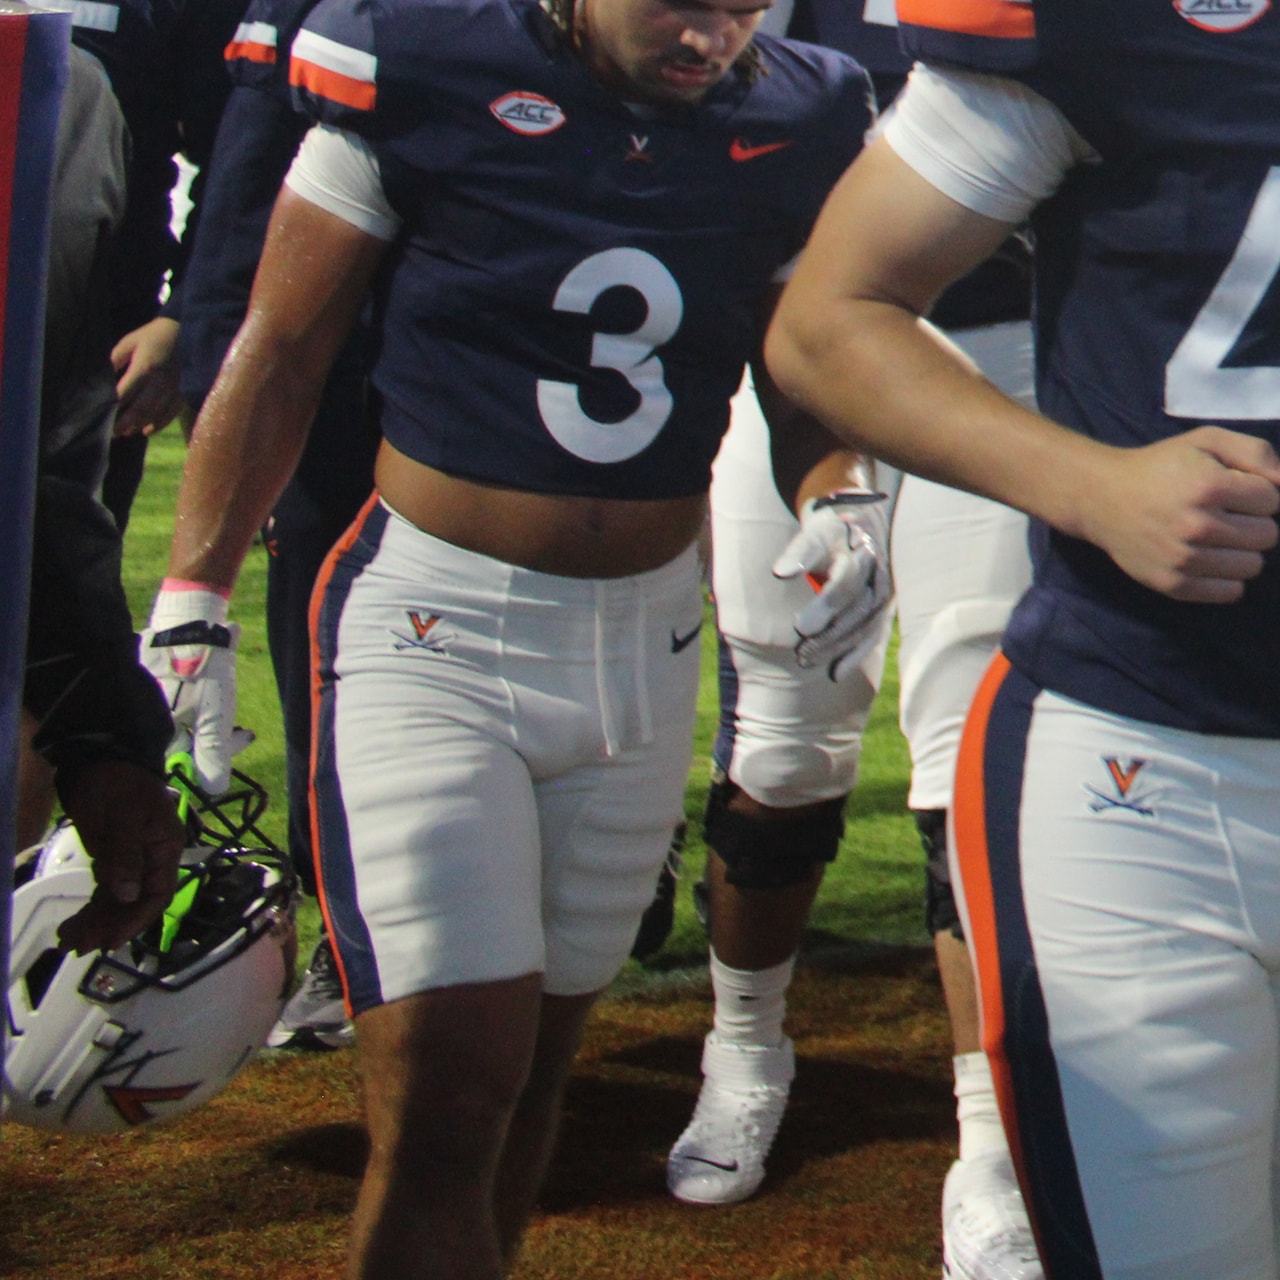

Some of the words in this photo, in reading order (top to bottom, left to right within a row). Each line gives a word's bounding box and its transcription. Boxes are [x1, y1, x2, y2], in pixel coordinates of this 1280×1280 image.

[500, 102, 557, 123] ACC
[536, 246, 684, 464] 3
[406, 609, 443, 641] V
[1102, 755, 1147, 799] V
